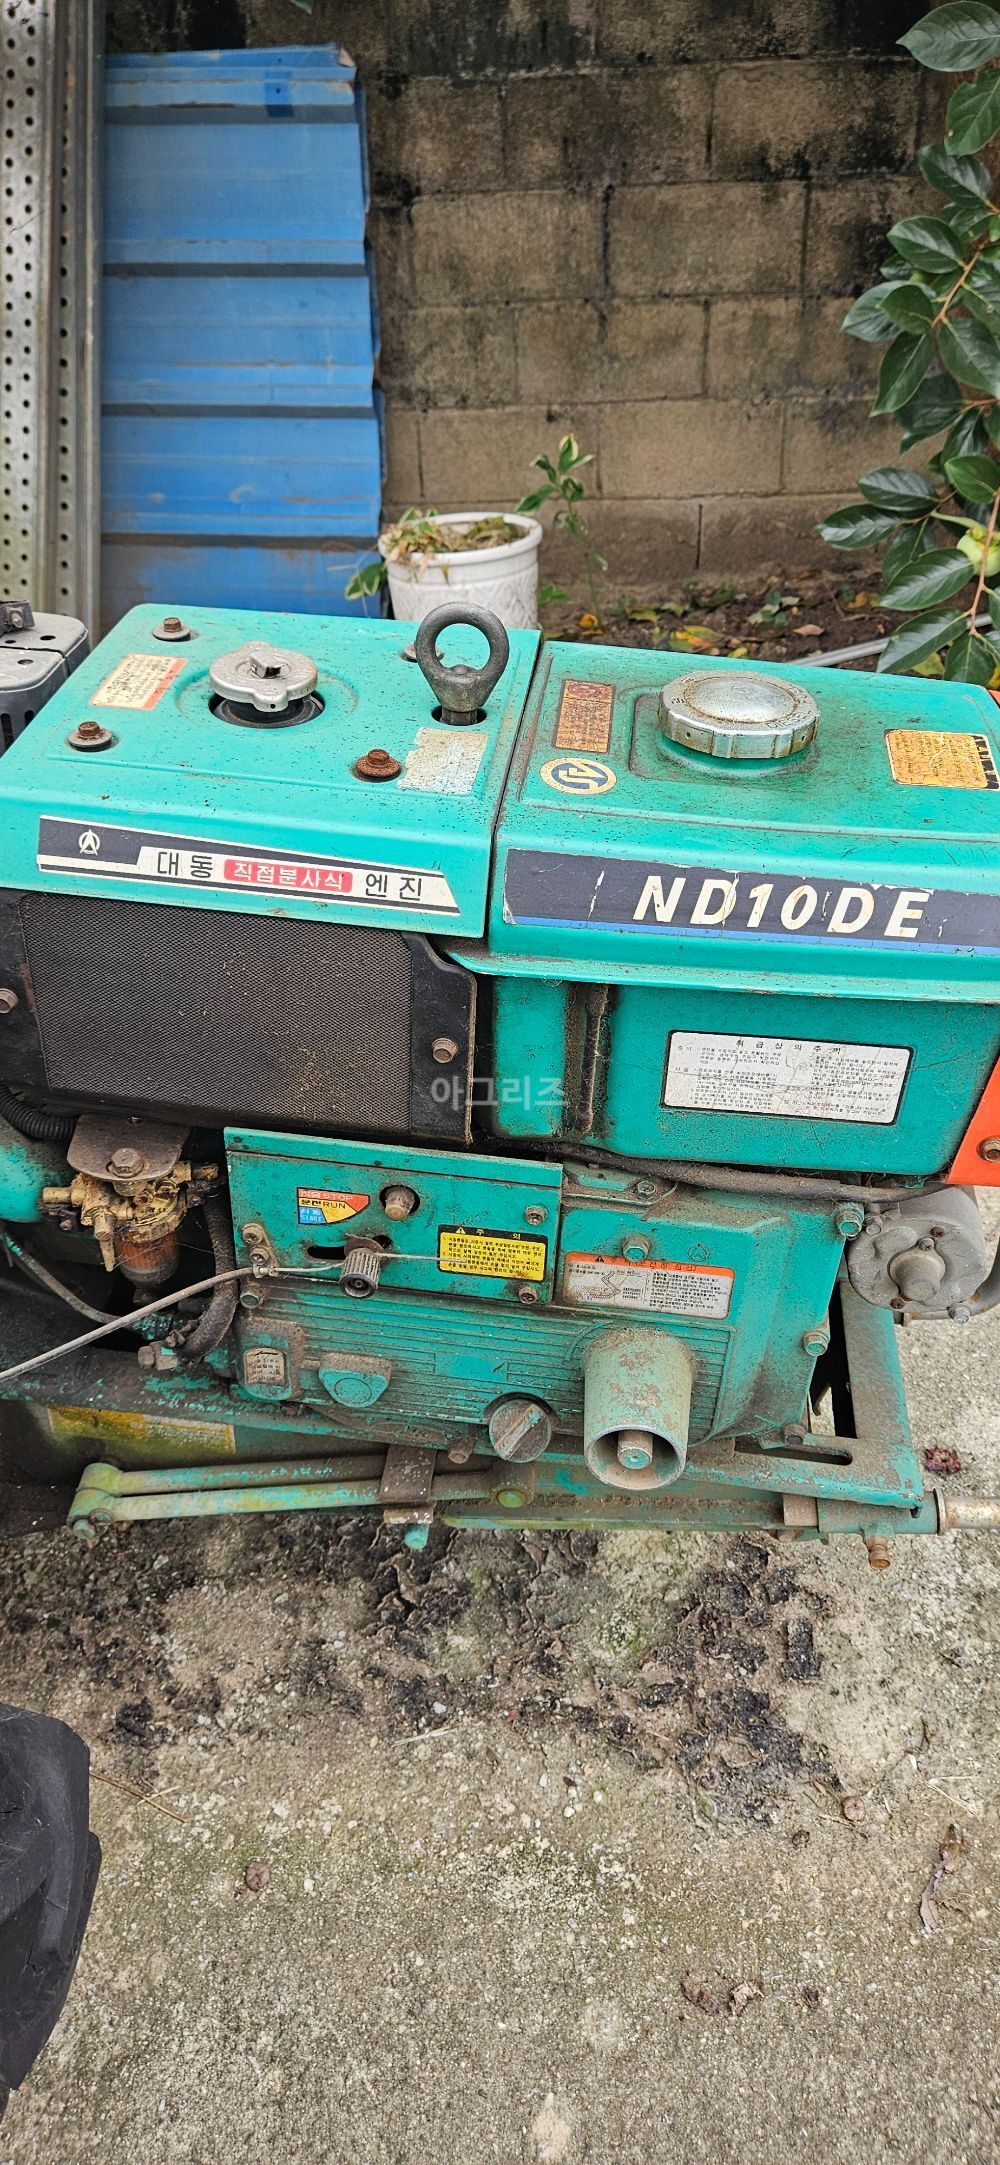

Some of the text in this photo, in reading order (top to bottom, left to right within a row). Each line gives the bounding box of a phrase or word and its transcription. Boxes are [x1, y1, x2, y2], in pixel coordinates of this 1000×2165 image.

[157, 850, 423, 901] 대동 직접분사식 엔진
[632, 875, 931, 938] ND10DE
[323, 1193, 353, 1201] STOP
[323, 1201, 346, 1209] RUN
